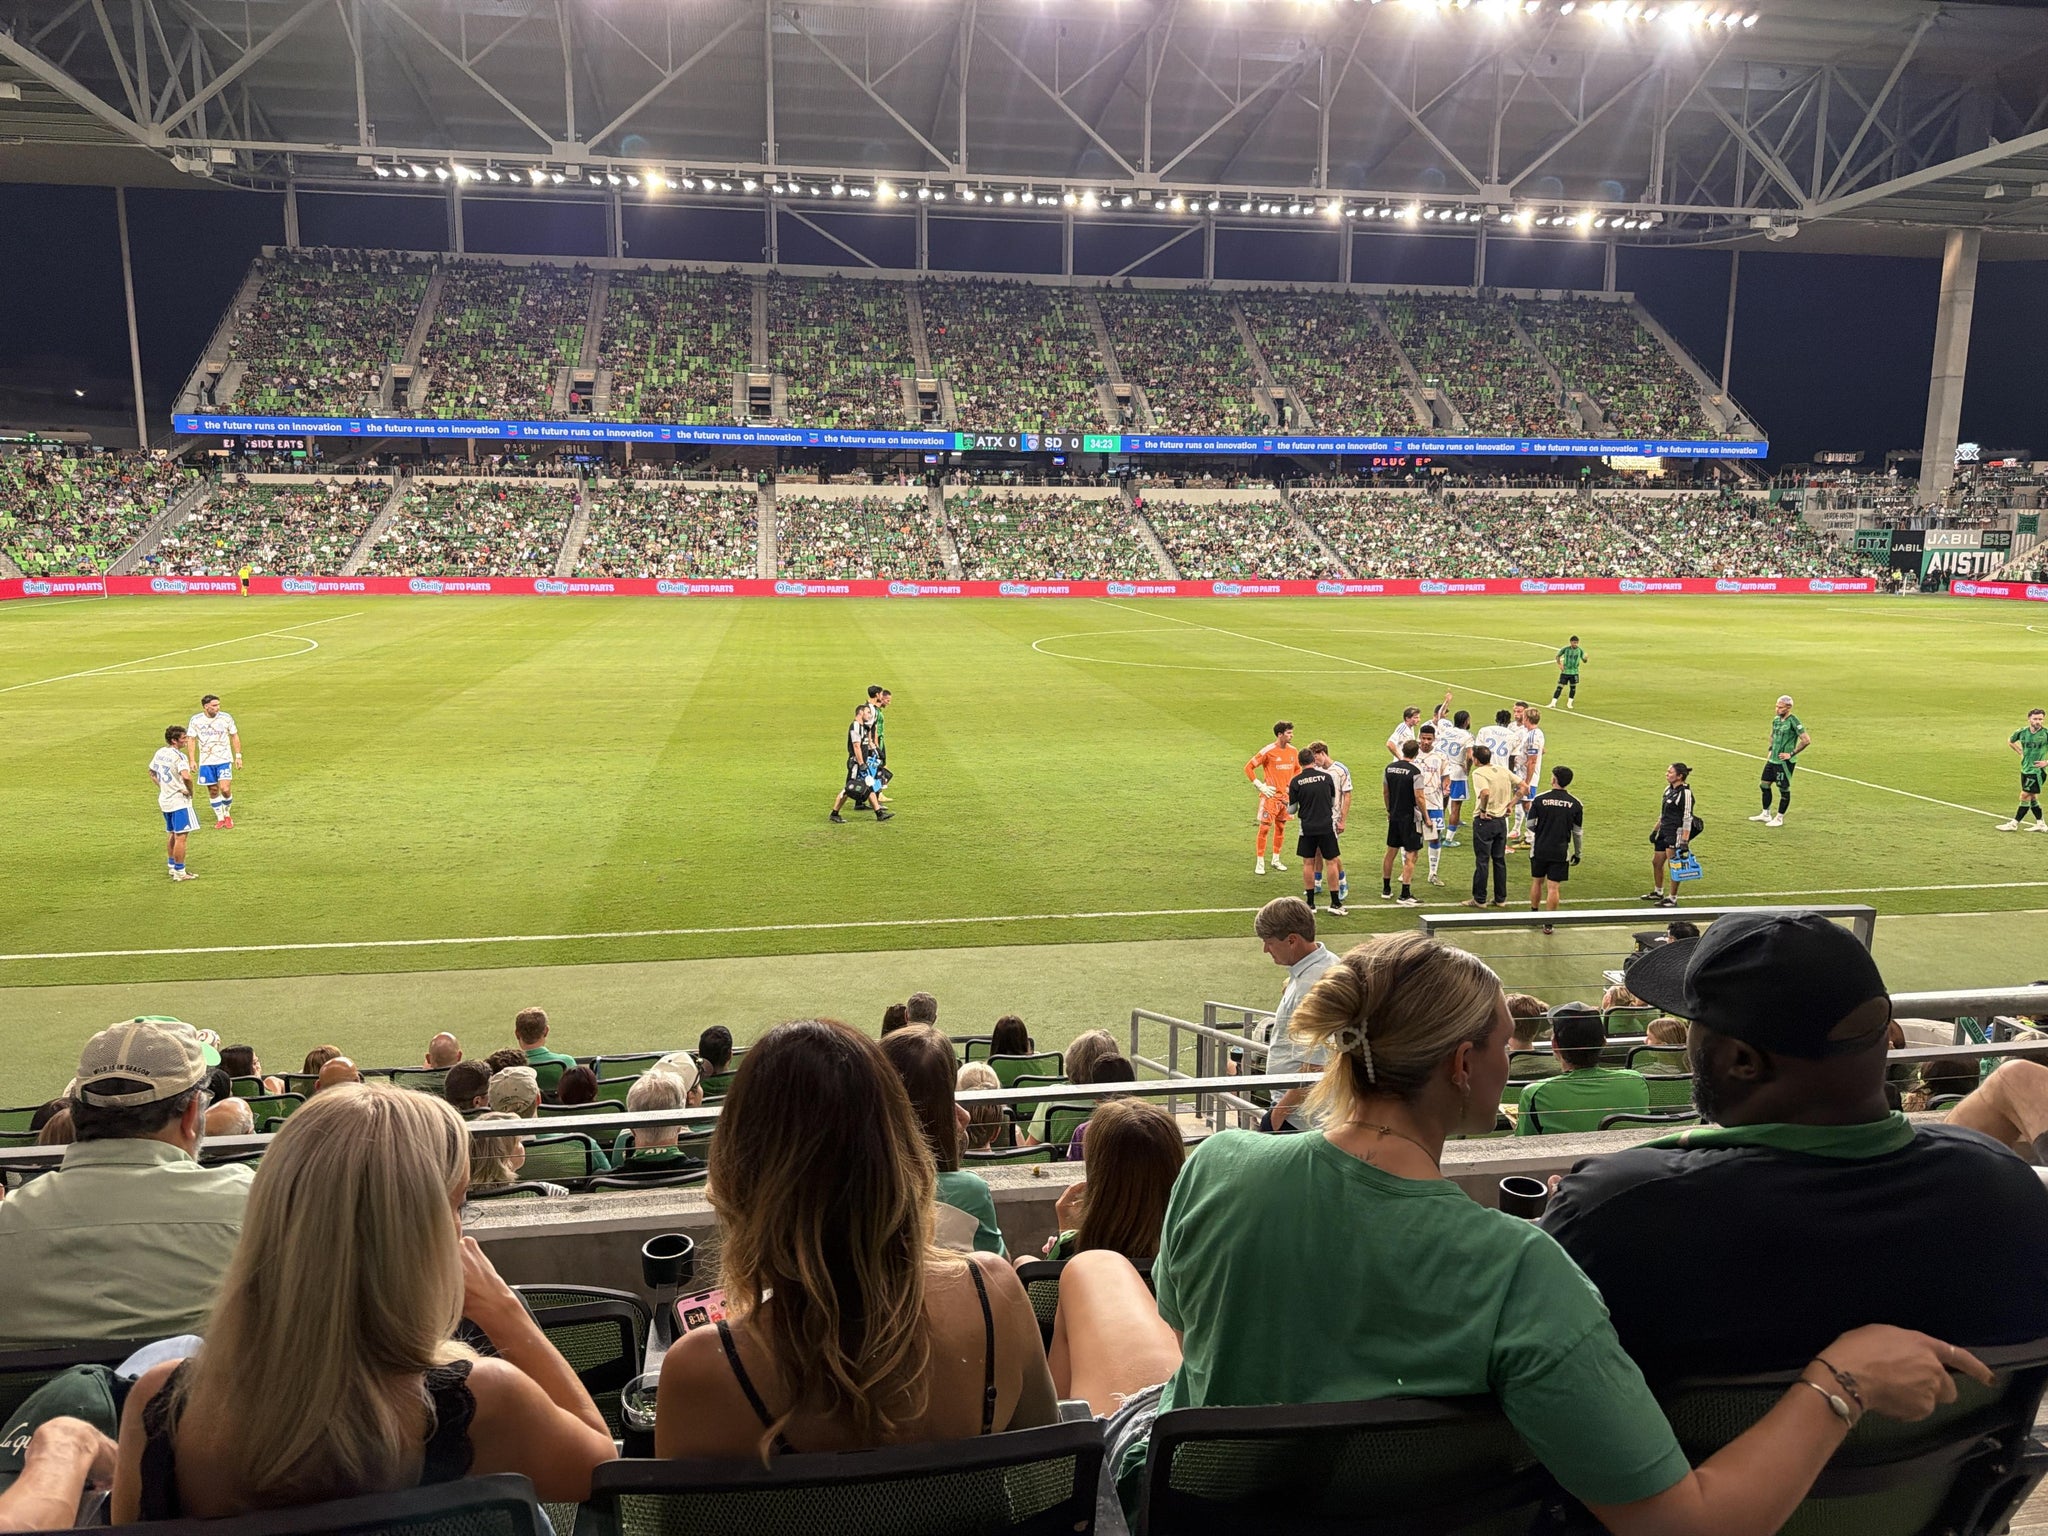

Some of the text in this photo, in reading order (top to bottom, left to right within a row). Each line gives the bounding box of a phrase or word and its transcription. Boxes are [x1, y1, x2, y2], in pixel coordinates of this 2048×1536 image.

[205, 422, 220, 430] the
[223, 422, 252, 430] future
[293, 423, 341, 432] innovation
[367, 424, 382, 432] the
[385, 424, 413, 433] future
[452, 426, 499, 434] innovation
[524, 427, 538, 435] the
[541, 428, 569, 436] future
[607, 429, 653, 438] innovation
[677, 431, 691, 439] the
[694, 432, 720, 440] future
[757, 433, 801, 442] innovation
[276, 440, 304, 448] EATS
[824, 435, 837, 443] the
[840, 436, 866, 444] future
[977, 437, 1016, 447] ATX 0
[1045, 438, 1079, 448] SD 0
[1091, 440, 1113, 448] 34:23
[1160, 441, 1184, 449] future
[1217, 442, 1257, 450] innovation
[1278, 442, 1290, 450] the
[1422, 443, 1445, 451] future
[1670, 446, 1692, 454] future
[1722, 447, 1757, 455] innovation
[1858, 538, 1888, 550] ATX
[1928, 534, 1978, 545] JABIL
[1892, 544, 1922, 552] JABIL
[1927, 552, 2005, 574] AUSTIN
[53, 583, 76, 592] AUTO
[76, 582, 102, 591] PARTS
[188, 582, 211, 590] AUTO
[213, 582, 236, 590] PARTS
[319, 583, 341, 591] AUTO
[342, 583, 365, 591] PARTS
[690, 584, 711, 592] AUTO
[712, 584, 733, 592] PARTS
[1977, 586, 1991, 594] AUTO
[1440, 738, 1460, 756] 20
[1486, 738, 1508, 756] 26
[220, 768, 230, 777] 25
[1387, 767, 1411, 775] DIRECTV
[1298, 776, 1326, 785] DIRECTV
[1542, 800, 1573, 808] DIRECTV
[93, 1066, 107, 1074] WILD
[126, 1064, 150, 1076] SEASON
